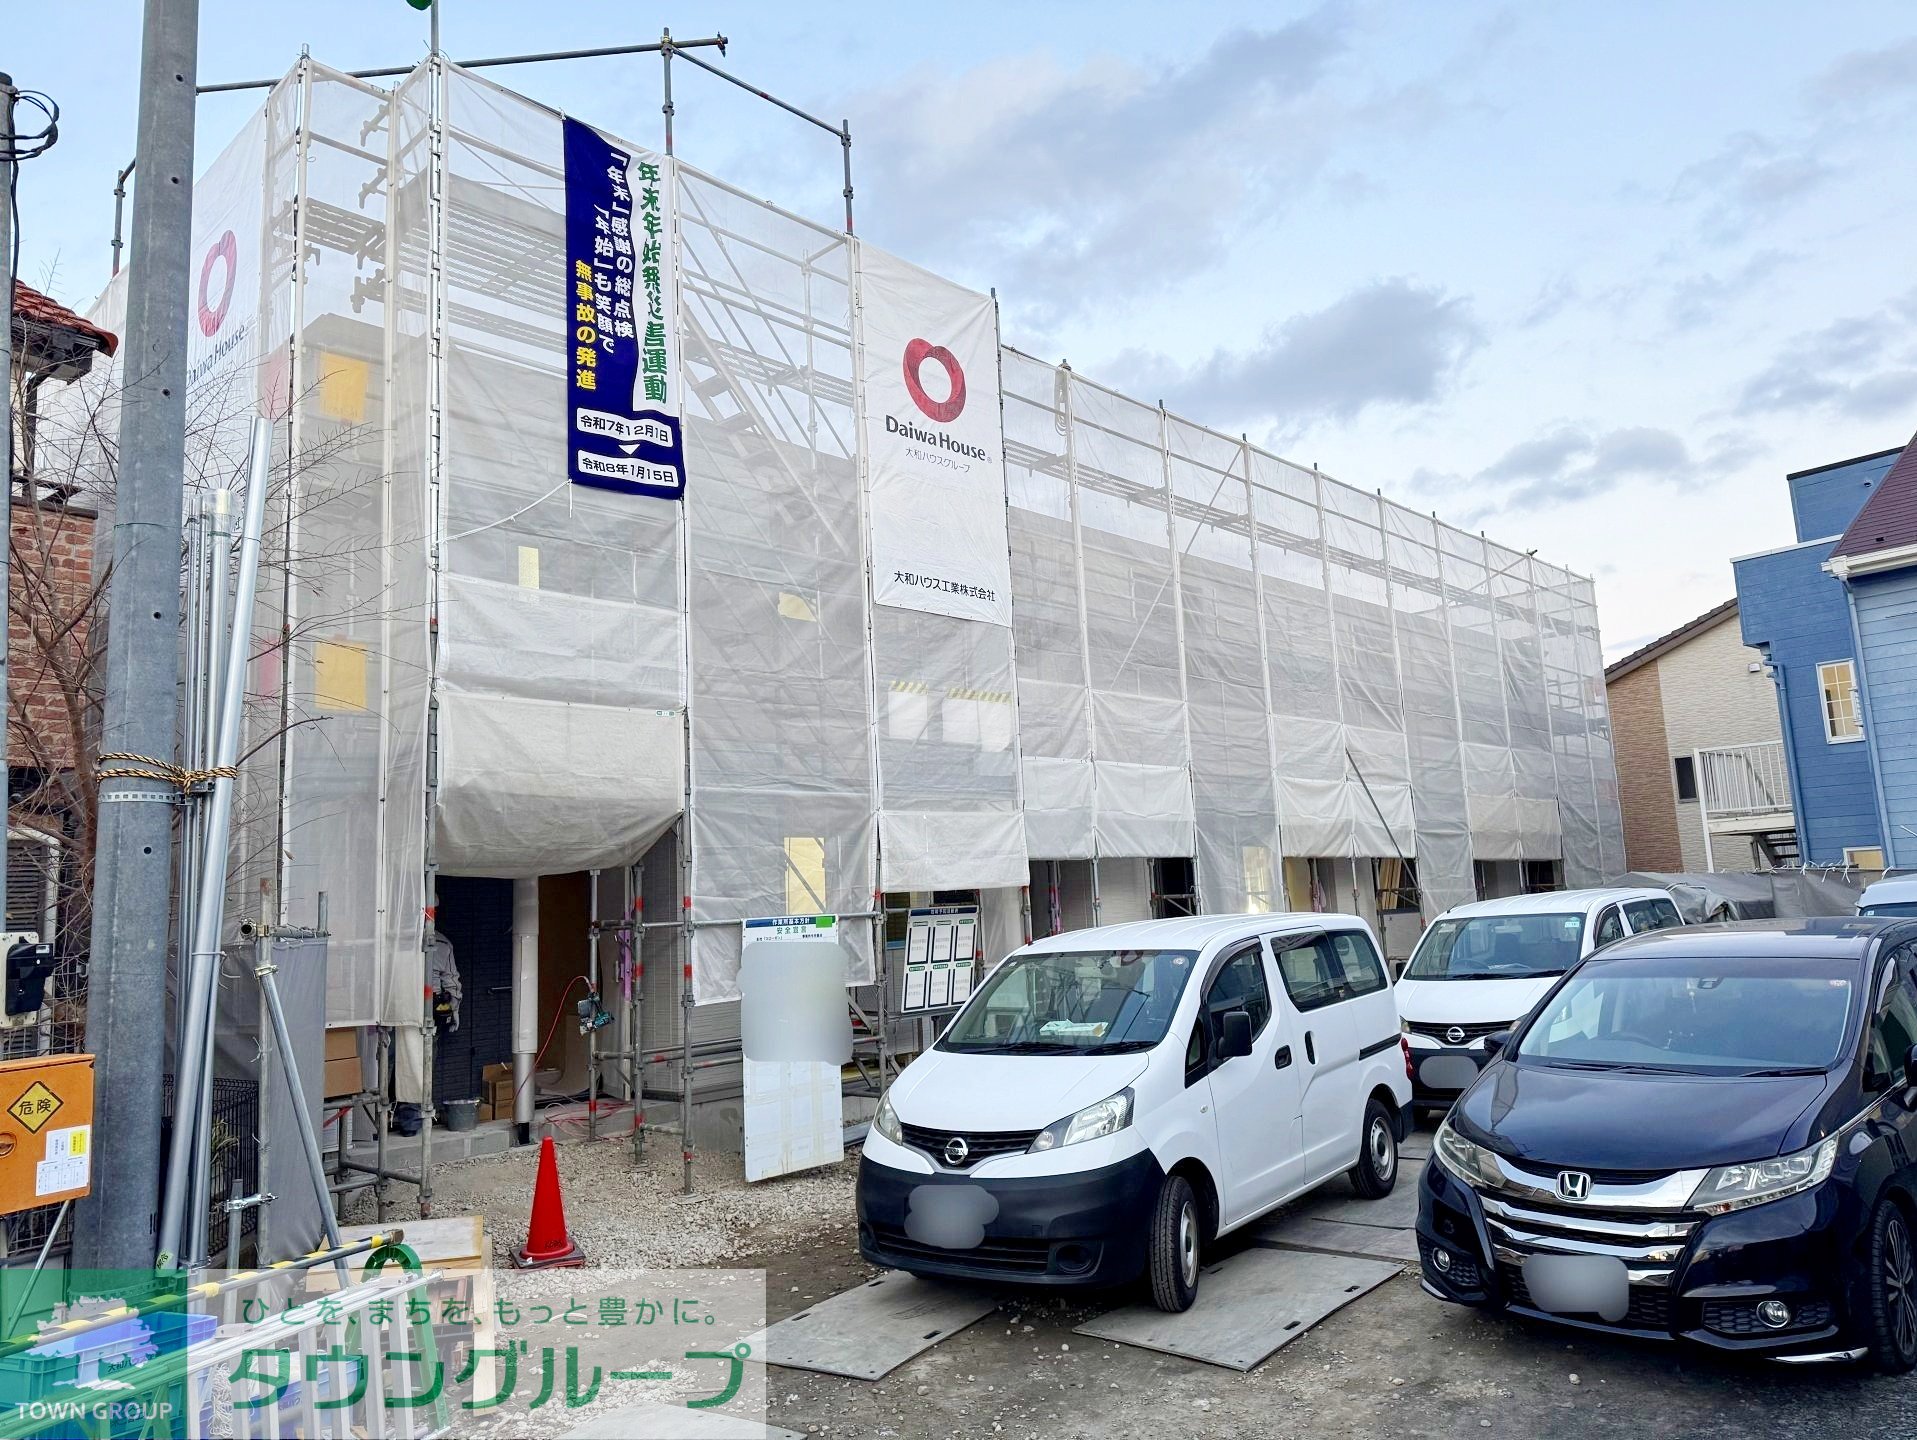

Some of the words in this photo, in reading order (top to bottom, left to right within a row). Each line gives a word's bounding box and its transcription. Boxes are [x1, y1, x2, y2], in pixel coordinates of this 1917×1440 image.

[607, 152, 634, 339] 「年末」感謝の総点検
[593, 203, 615, 354] 「年始」も笑顔で
[637, 161, 668, 405] 年末年始無災害運動
[575, 259, 597, 391] 無事故の発進
[580, 414, 669, 443] 令和7年12月1日
[885, 414, 937, 446] Daiwa
[939, 431, 986, 461] House
[582, 457, 674, 483] 令和8年1月15日
[905, 447, 971, 473] 大和ハウスグループ
[893, 570, 996, 602] 大和ハウス工業株式会社
[18, 1098, 52, 1117] 危険
